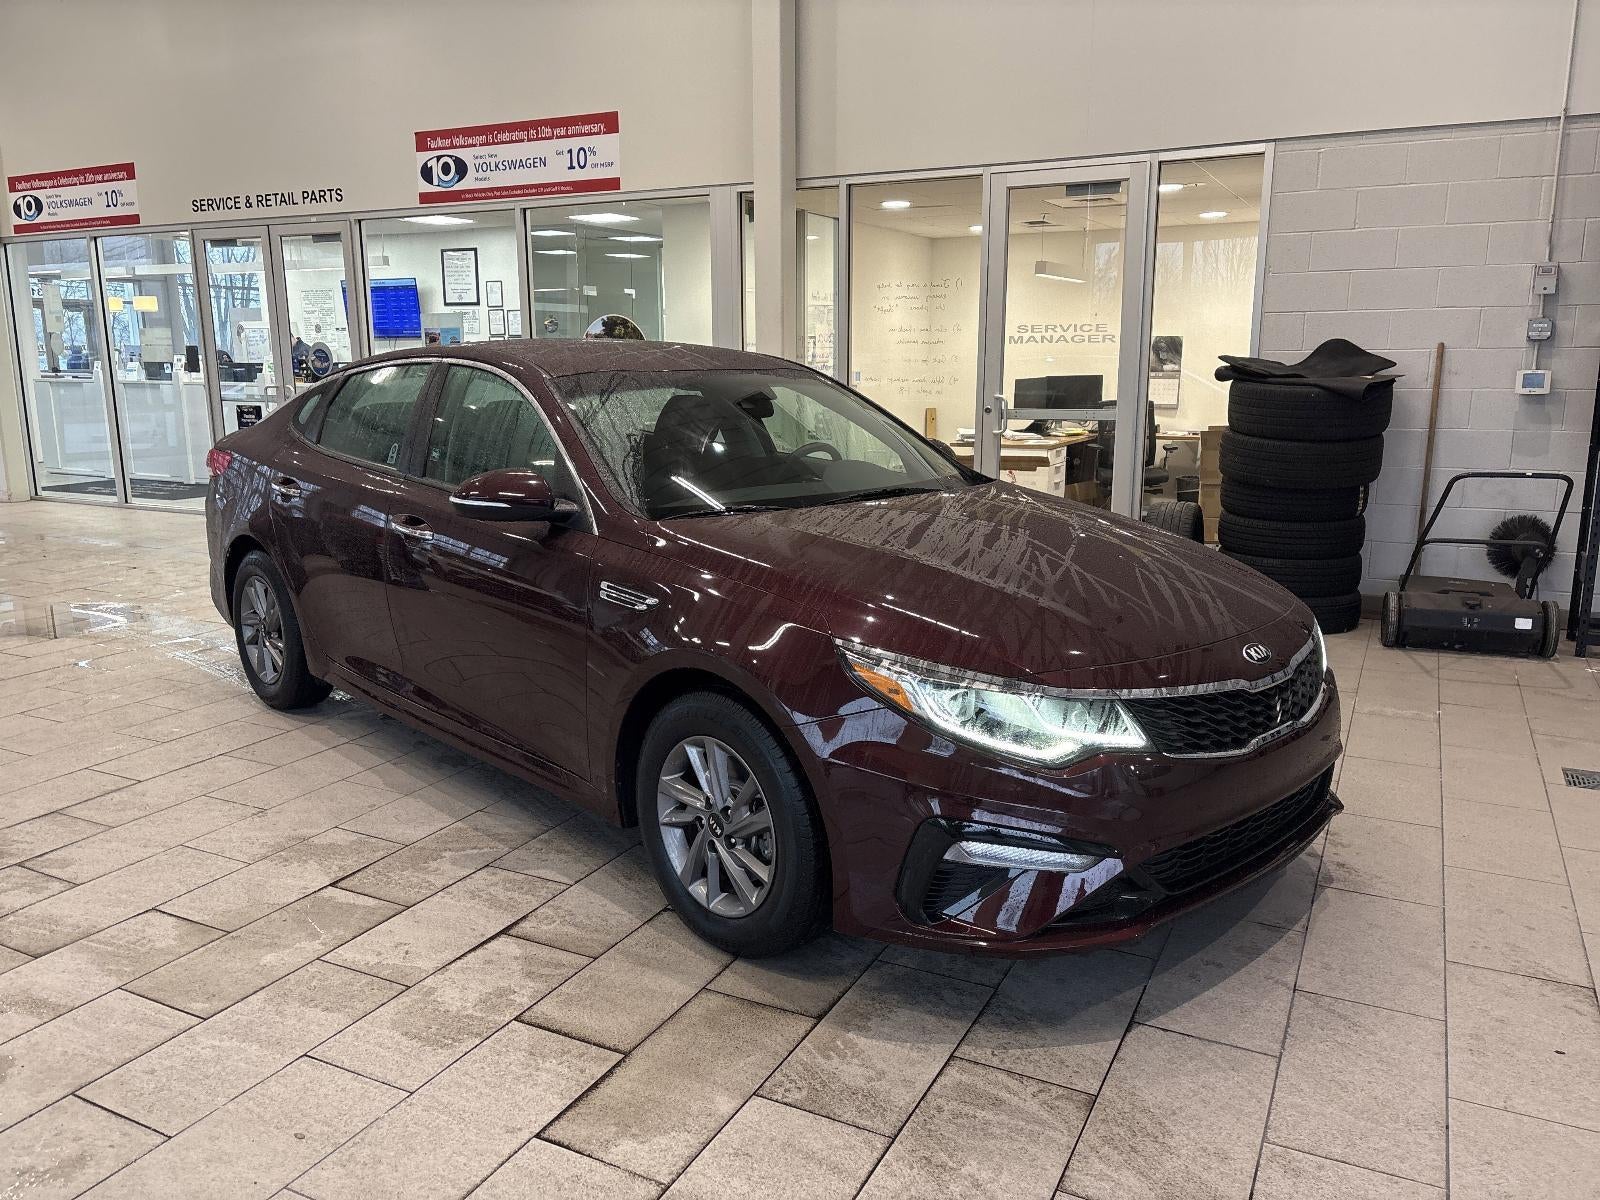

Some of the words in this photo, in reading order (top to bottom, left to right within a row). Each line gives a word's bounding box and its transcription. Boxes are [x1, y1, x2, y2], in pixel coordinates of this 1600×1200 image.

[427, 136, 451, 148] Faulkner
[452, 134, 487, 147] Volkswagen
[488, 132, 493, 142] is
[493, 128, 528, 142] Celebrating
[538, 126, 551, 138] 10th
[552, 127, 566, 138] year
[567, 122, 606, 135] anniversary.
[473, 156, 546, 174] VOLKSWAGEN
[46, 197, 93, 210] VOLKSWAGEN
[192, 196, 241, 212] SERVICE
[245, 195, 253, 208] &
[256, 192, 298, 208] RETAIL
[302, 188, 343, 204] PARTS
[1017, 324, 1108, 334] SERVICE
[1008, 334, 1116, 344] MANAGER
[1246, 645, 1270, 660] KIA
[710, 816, 722, 835] KIA
